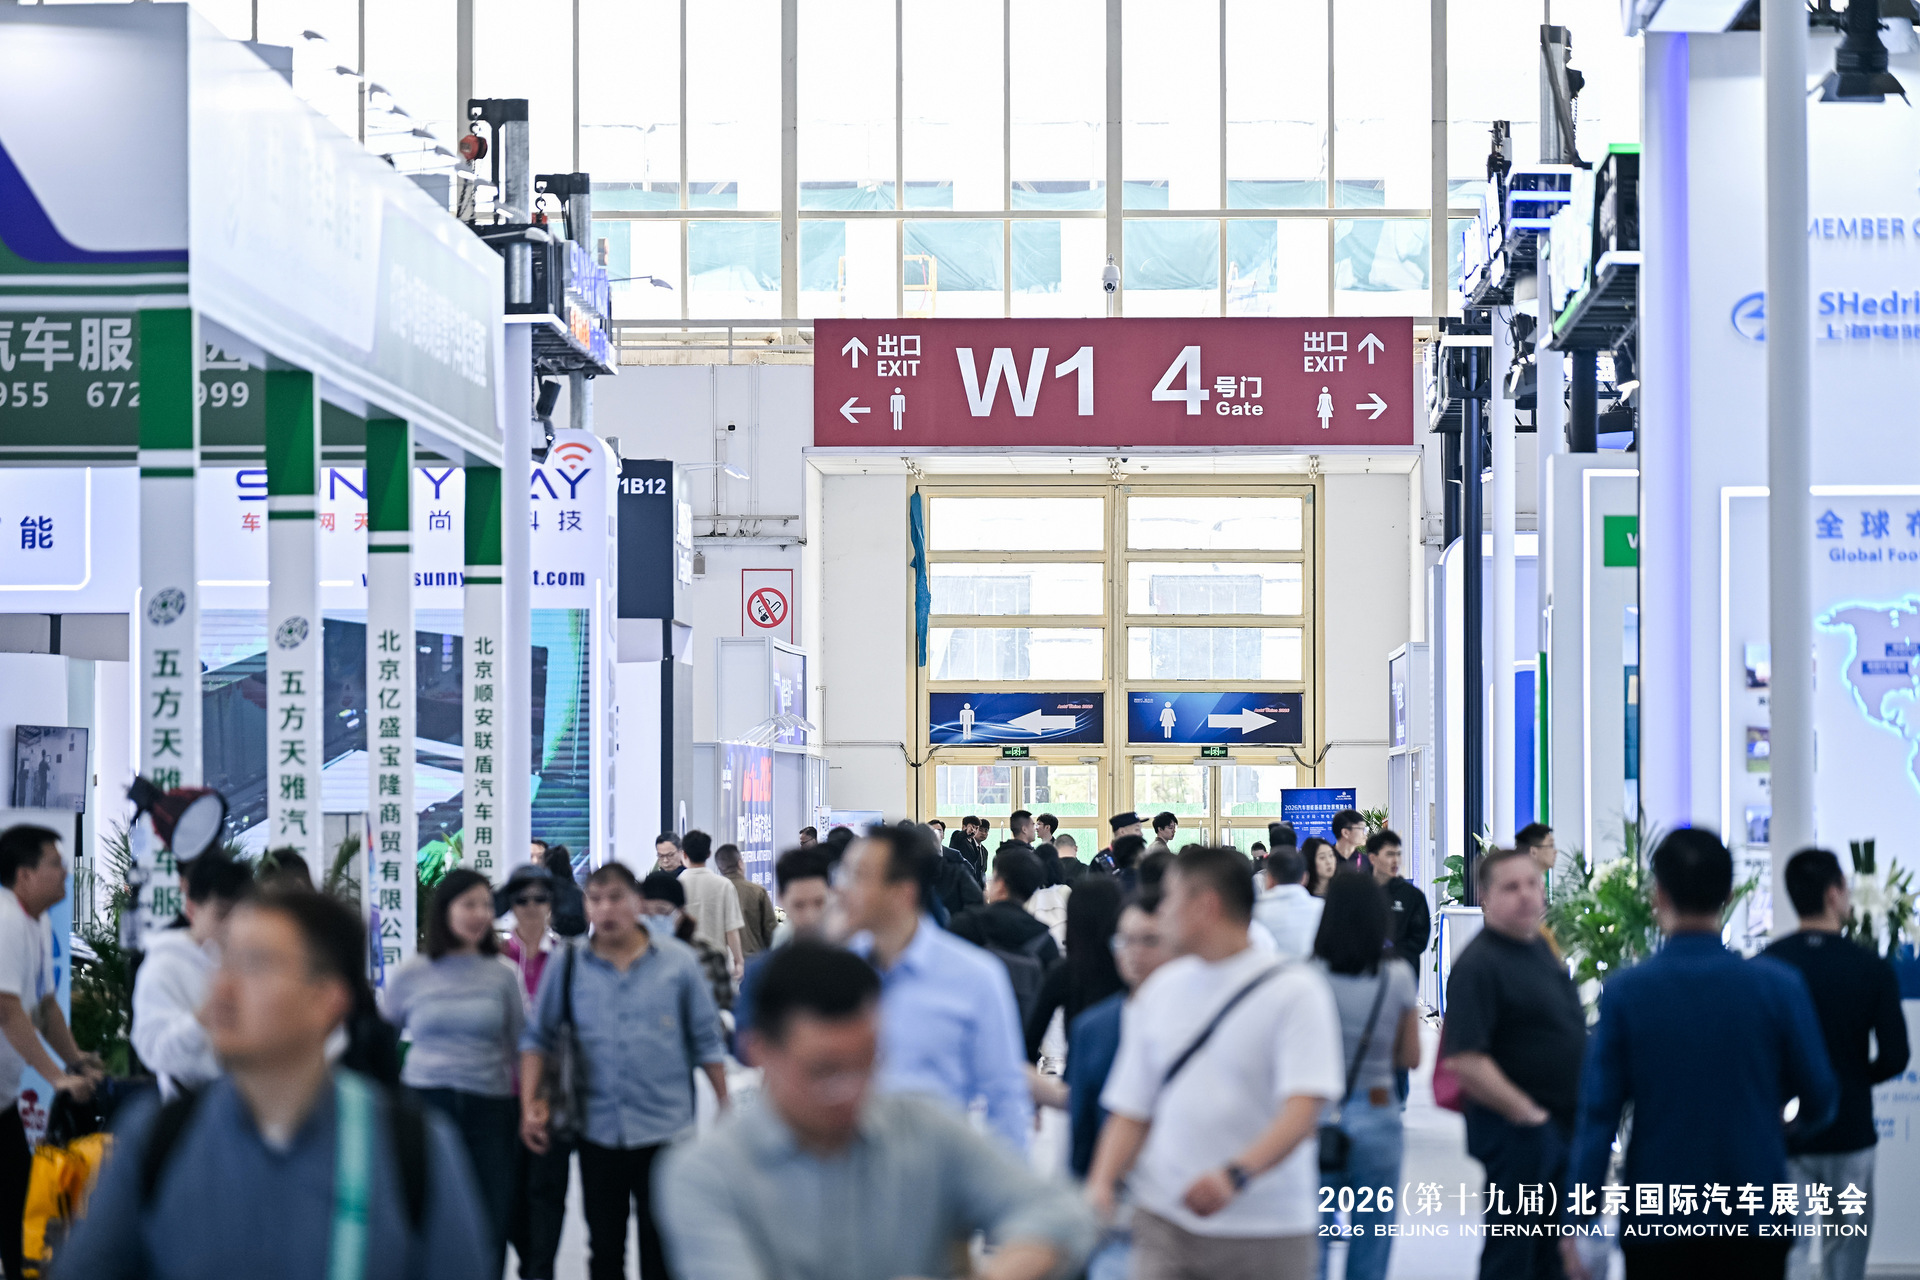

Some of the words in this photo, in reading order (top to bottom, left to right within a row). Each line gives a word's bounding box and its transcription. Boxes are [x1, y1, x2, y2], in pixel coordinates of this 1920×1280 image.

[1807, 217, 1904, 238] MEMBER
[877, 334, 921, 357] 出口
[1303, 331, 1348, 353] 出口
[877, 360, 920, 377] EXIT
[1304, 356, 1348, 372] EXIT
[955, 346, 1095, 417] W1
[1151, 345, 1210, 416] 4
[1214, 375, 1263, 398] 号门
[1215, 401, 1264, 416] Gate
[617, 477, 667, 495] 1B12
[20, 515, 54, 549] 能
[1829, 548, 1883, 562] Global
[1888, 548, 1920, 562] Foo
[280, 670, 307, 850] 五方天雅汽
[474, 636, 494, 880] 北京顺安联盾汽车用品
[378, 629, 402, 966] 北京亿盛宝隆商贸有限公司
